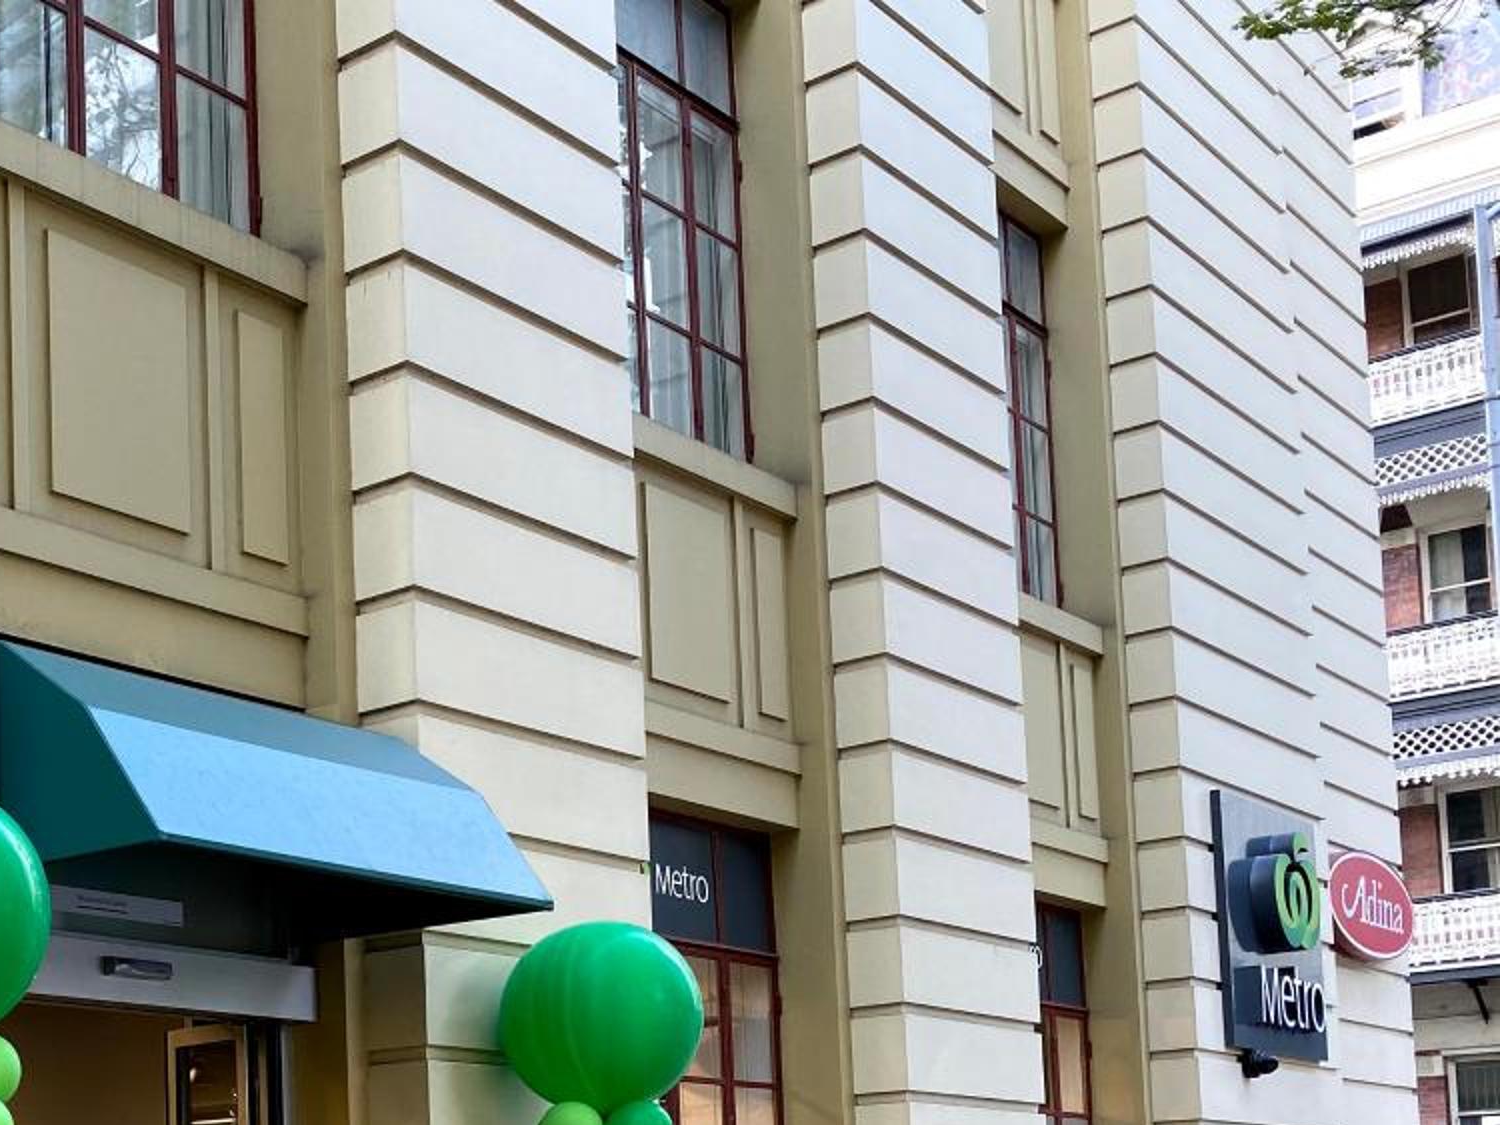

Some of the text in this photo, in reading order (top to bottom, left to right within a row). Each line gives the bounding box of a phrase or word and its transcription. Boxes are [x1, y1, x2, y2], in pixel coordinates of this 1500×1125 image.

[655, 863, 709, 903] Metro
[1341, 874, 1404, 934] Adina
[1261, 963, 1327, 1033] Metro
